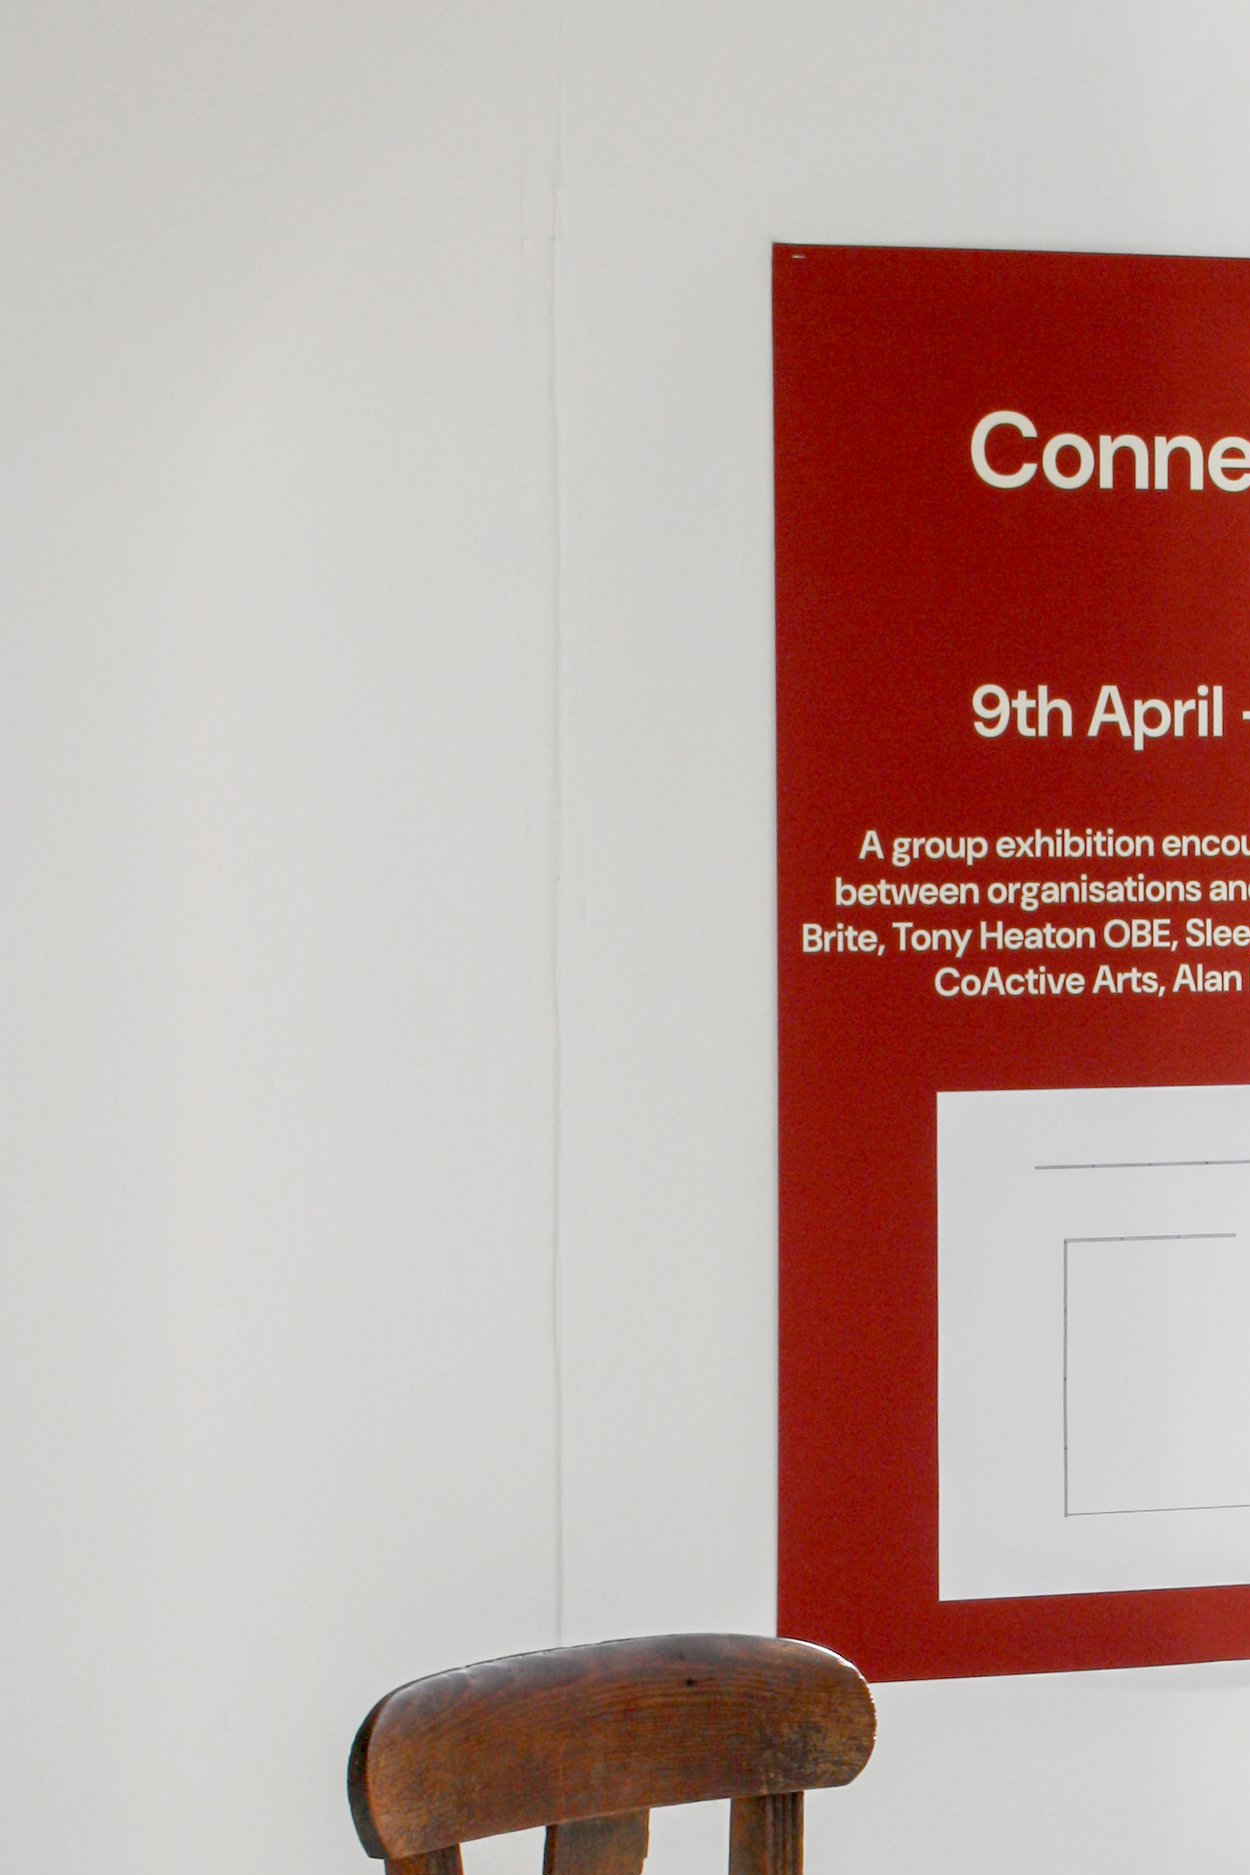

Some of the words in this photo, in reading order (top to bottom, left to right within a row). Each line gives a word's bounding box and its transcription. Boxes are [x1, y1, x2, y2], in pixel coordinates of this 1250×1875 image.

[973, 684, 1072, 737] 9th
[1088, 685, 1223, 751] April
[859, 830, 884, 859] A
[892, 837, 988, 867] group
[996, 828, 1154, 858] exhibition
[836, 877, 979, 906] between
[988, 874, 1202, 911] organisations
[803, 923, 885, 956] Brite,
[892, 922, 972, 957] Tony
[981, 921, 1095, 949] Heaton
[1104, 919, 1178, 951] OBE,
[935, 966, 1085, 996] CoActive
[1093, 965, 1165, 997] Arts,
[1173, 964, 1242, 992] Alan
